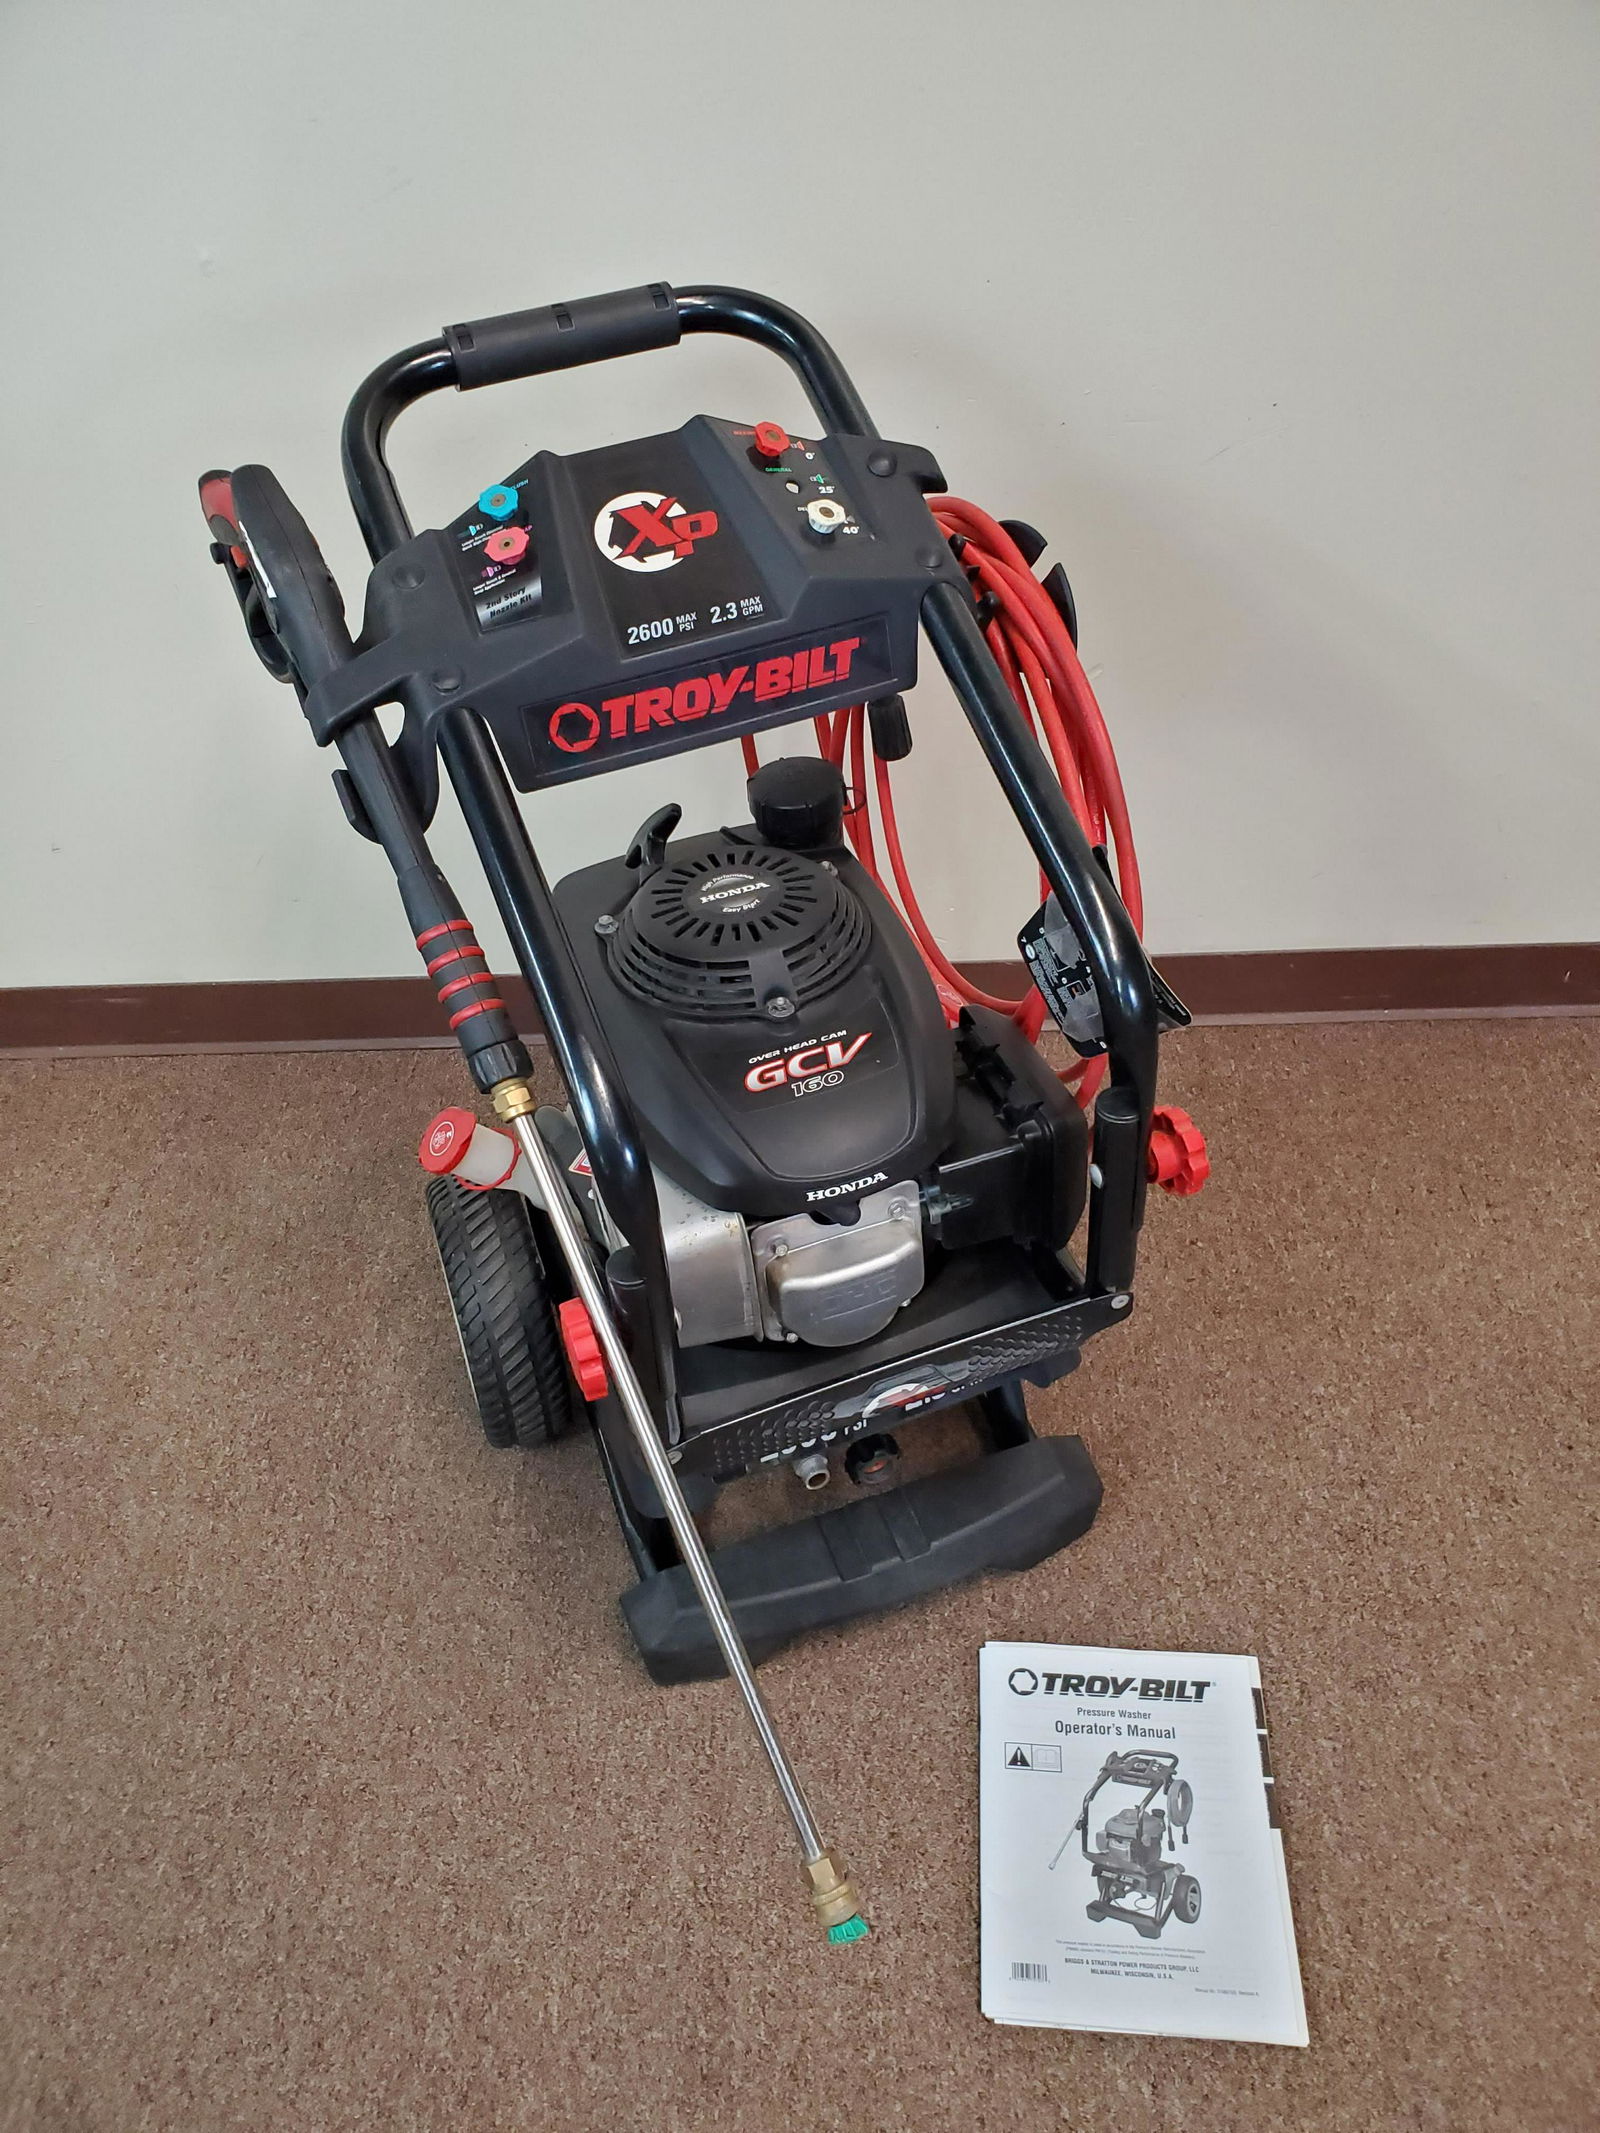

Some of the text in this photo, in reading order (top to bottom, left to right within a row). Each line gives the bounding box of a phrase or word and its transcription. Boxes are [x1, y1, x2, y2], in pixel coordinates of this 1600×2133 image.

[485, 586, 526, 609] 2nd Story
[489, 593, 532, 618] Nozzle Kit
[710, 596, 763, 624] 2.3 MAX GPM
[627, 611, 697, 645] 2600 MAX PSI
[602, 637, 860, 739] TROY-BILT
[700, 882, 770, 904] HONDA
[748, 1030, 847, 1064] OVER HEAD CAM
[744, 1032, 872, 1092] GCV
[791, 1070, 845, 1097] 160
[806, 1172, 888, 1202] HONDA
[1042, 1672, 1211, 1703] TROY-BILT
[1077, 1707, 1151, 1720] Pressure Washer
[1055, 1720, 1176, 1739] Operator's Manual
[1091, 1959, 1118, 1967] STRATTON
[1139, 1962, 1167, 1970] PRODUCTS
